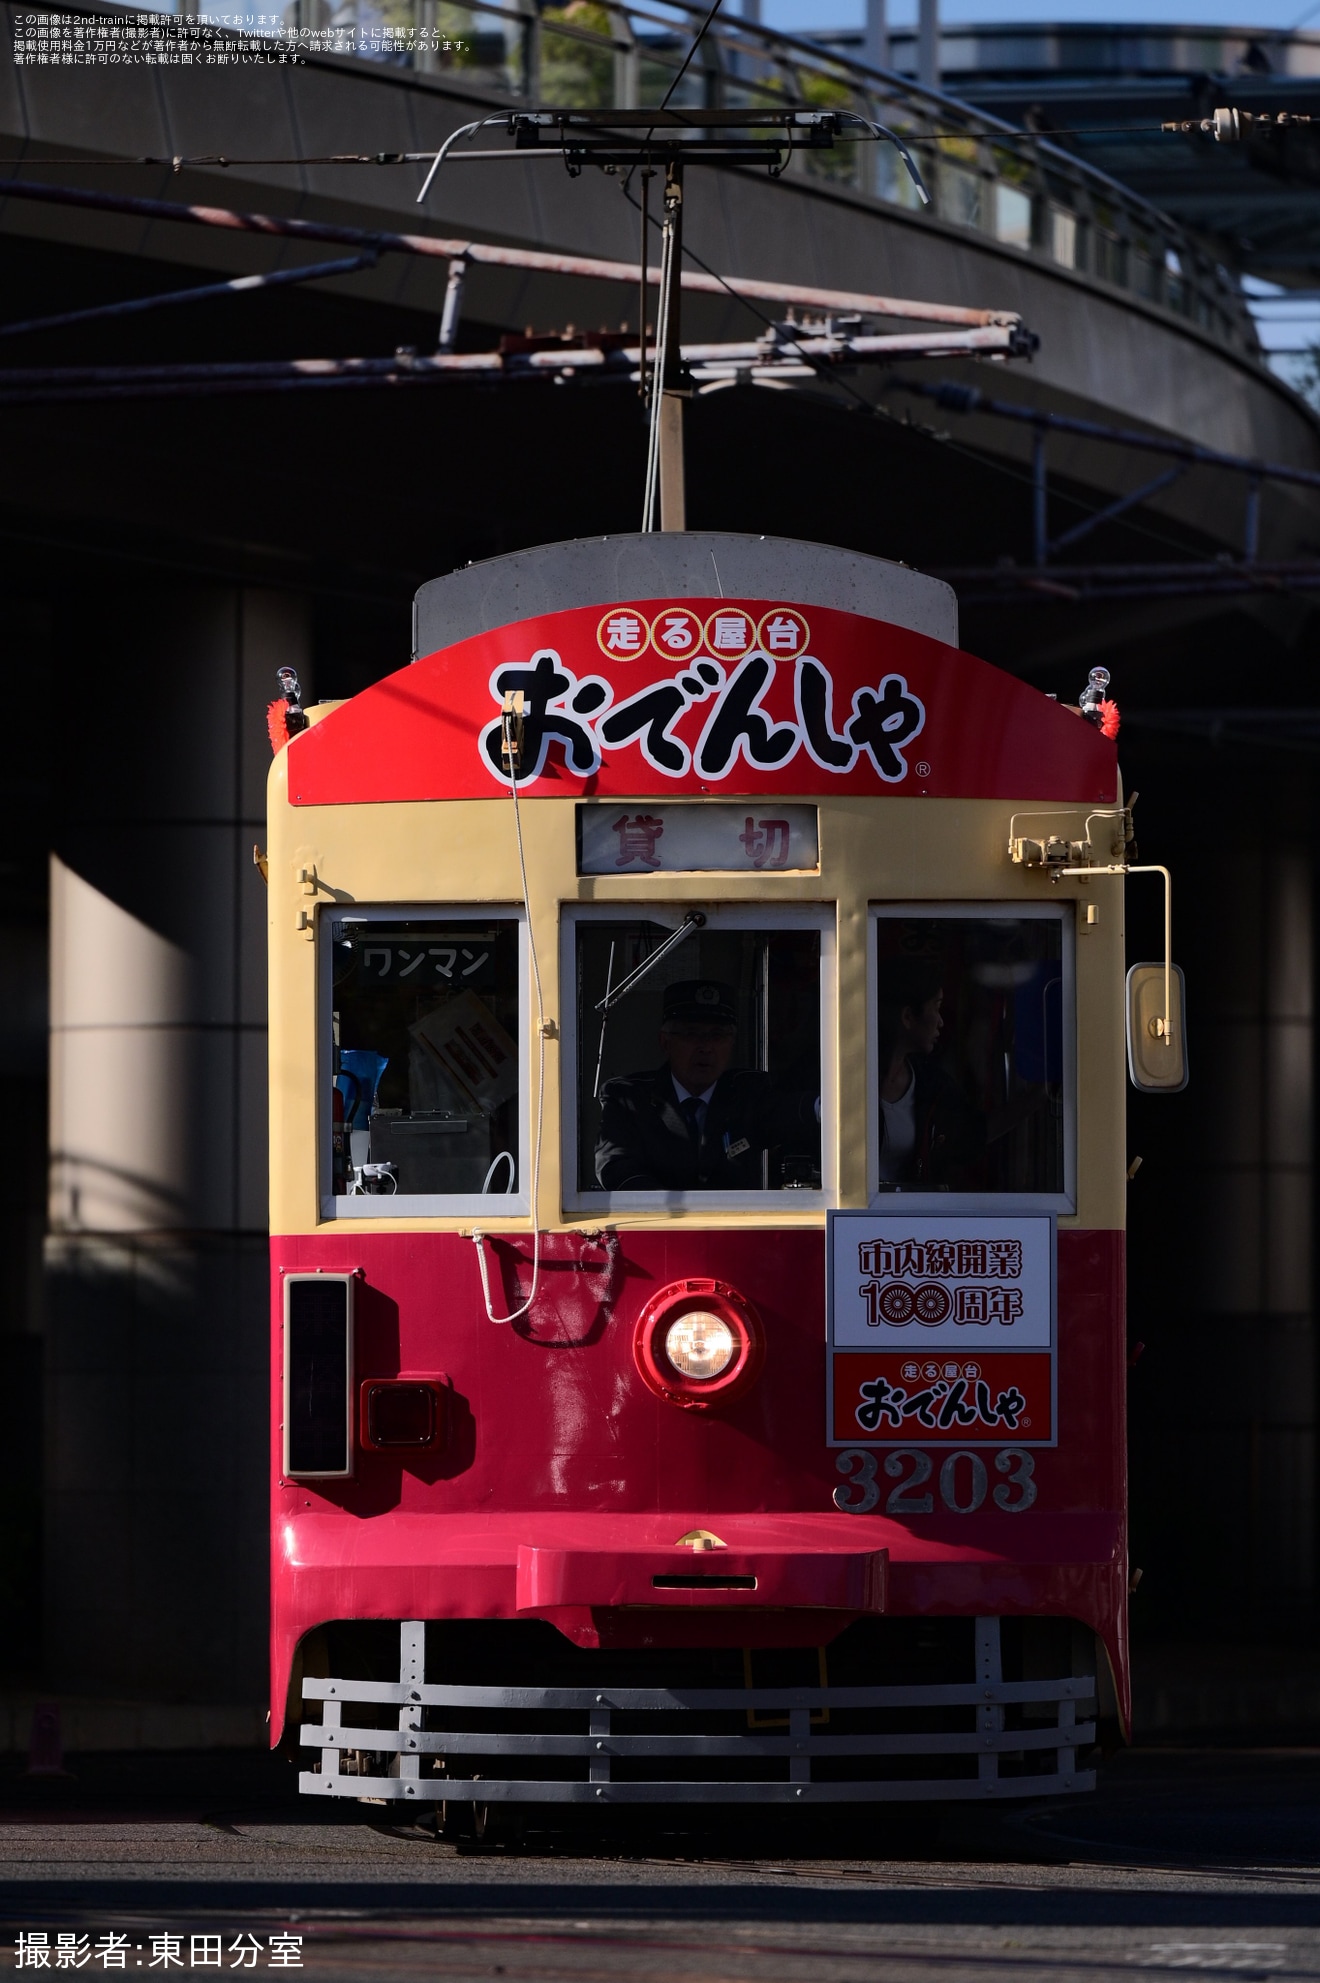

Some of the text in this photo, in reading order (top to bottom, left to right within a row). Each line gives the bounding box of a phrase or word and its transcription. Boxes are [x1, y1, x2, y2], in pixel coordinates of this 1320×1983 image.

[604, 613, 803, 652] 走る屋台
[363, 948, 489, 978] ワンマン
[858, 1239, 1023, 1278] 市内線開業
[858, 1281, 1024, 1327] 100周年
[902, 1363, 980, 1380] 走る屋台
[832, 1447, 1038, 1514] 3203
